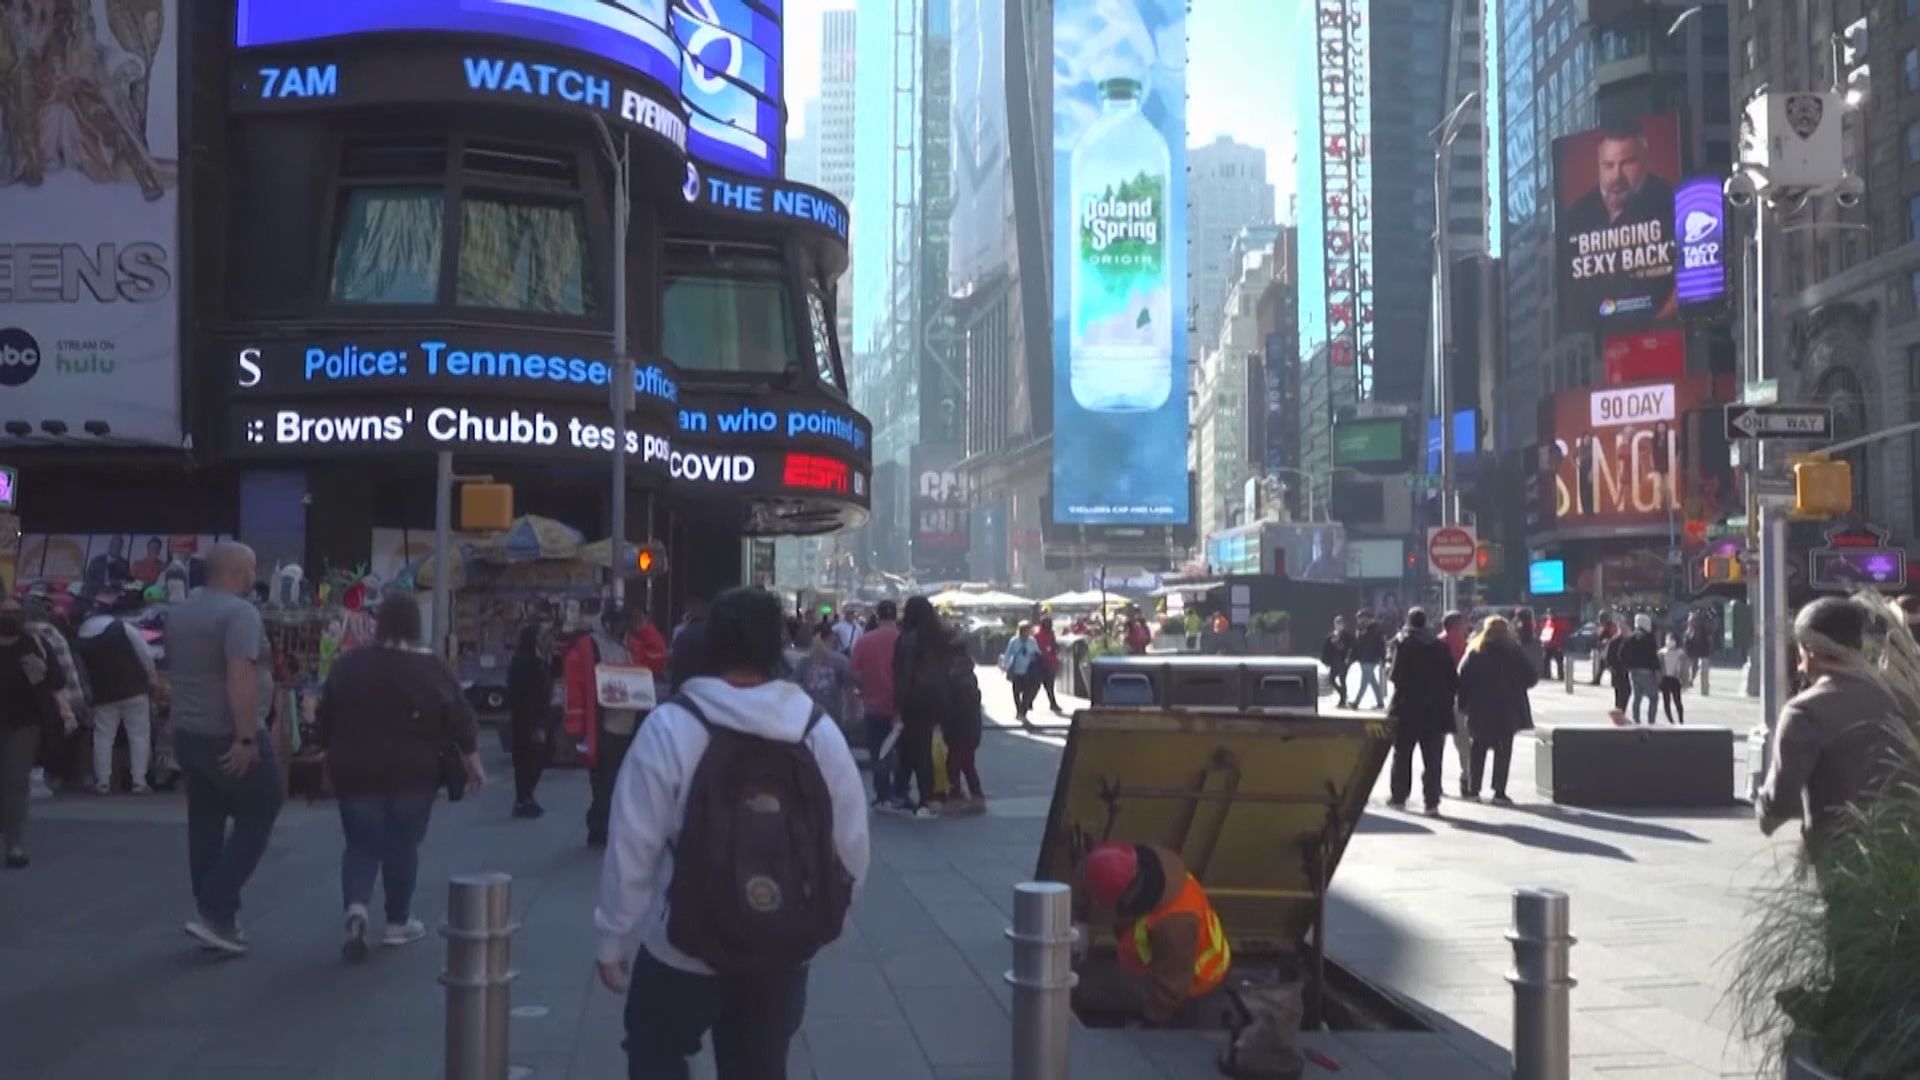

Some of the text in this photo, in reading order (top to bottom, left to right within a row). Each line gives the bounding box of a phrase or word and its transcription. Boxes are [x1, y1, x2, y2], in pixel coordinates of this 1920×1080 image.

[258, 64, 338, 98] 7AM
[463, 57, 611, 110] WATCH
[707, 177, 763, 212] THE
[773, 191, 837, 231] NEWS
[1083, 195, 1152, 230] Poland
[1091, 217, 1158, 251] Spring
[1683, 241, 1719, 256] TACO
[0, 241, 171, 303] ENS
[1088, 254, 1152, 265] ORIGIN
[1572, 252, 1617, 279] SEXY
[1684, 253, 1720, 269] BELL
[56, 339, 115, 351] STREAM ON
[56, 352, 115, 374] hulu
[304, 344, 408, 381] Police:
[420, 341, 613, 386] Tennesse
[1600, 391, 1664, 420] 90 DAY
[1742, 415, 1817, 430] ONE WAY
[276, 406, 414, 444] Browns'
[427, 407, 559, 446] Chubb
[717, 407, 778, 433] who
[787, 410, 853, 443] pointed
[669, 450, 756, 482] COVID
[783, 452, 849, 494] ESPN
